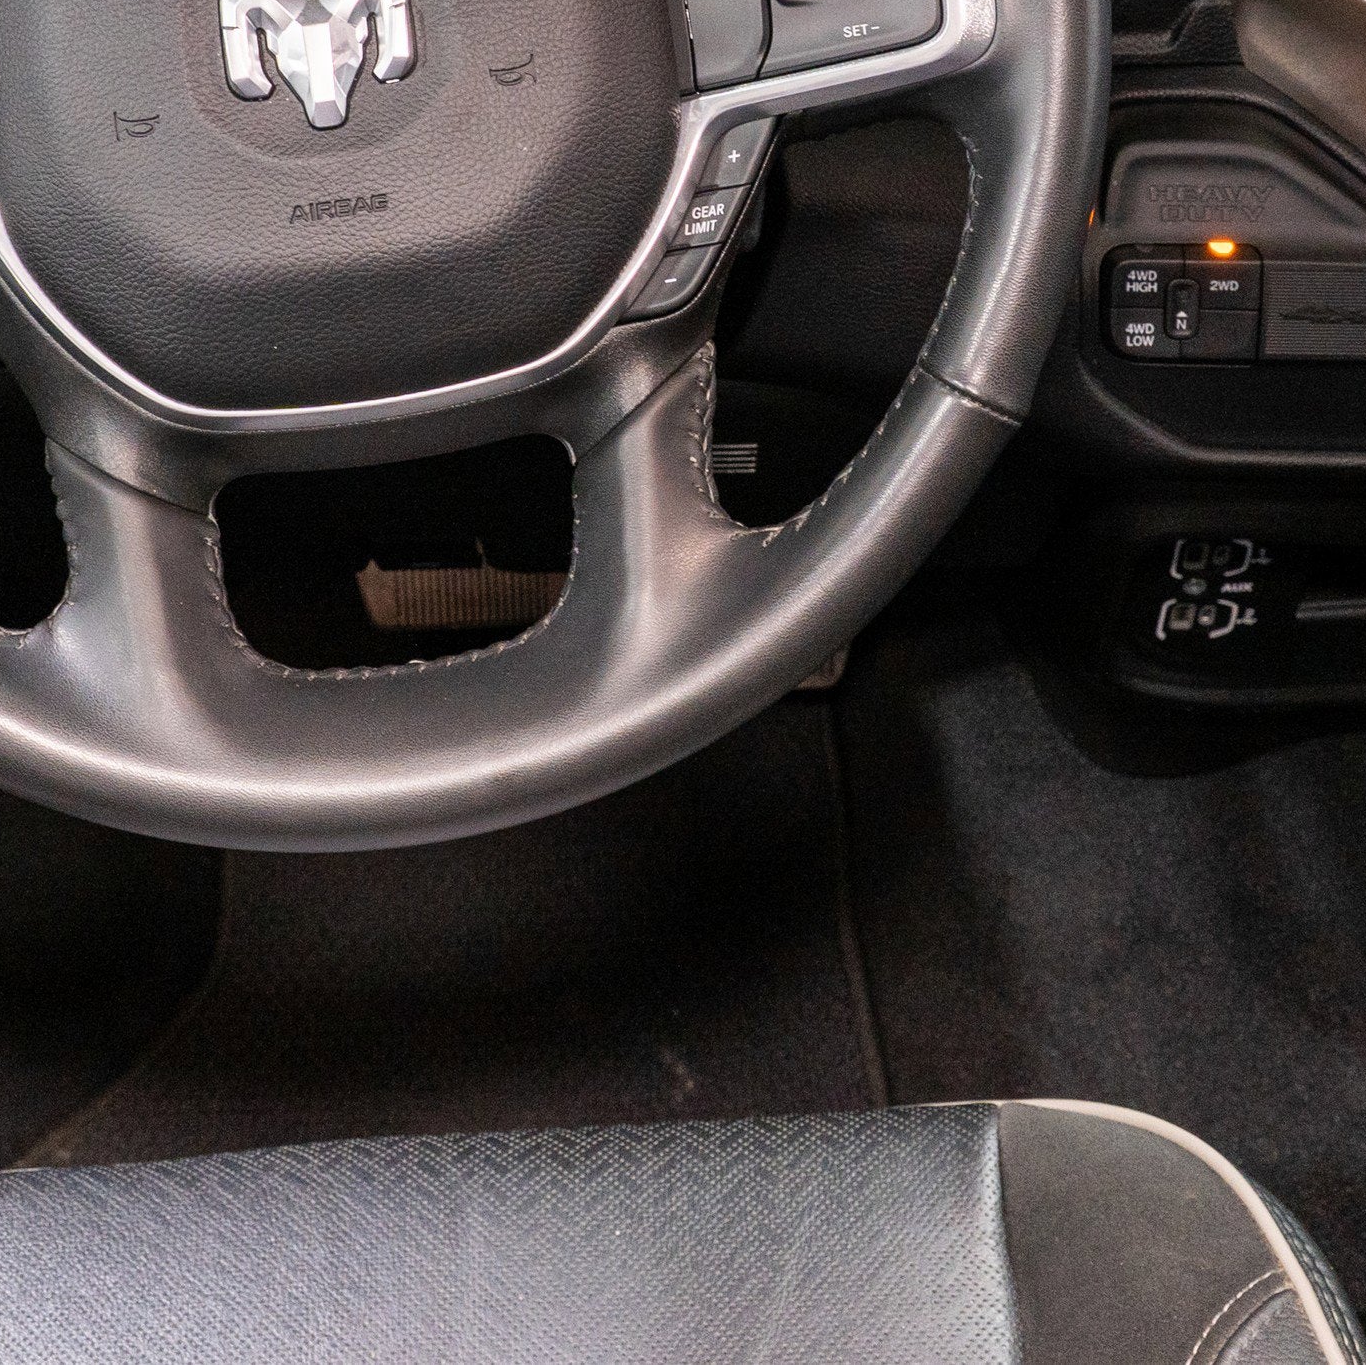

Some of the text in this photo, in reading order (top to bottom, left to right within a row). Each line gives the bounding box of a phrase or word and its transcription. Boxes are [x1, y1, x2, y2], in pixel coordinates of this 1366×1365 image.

[1149, 184, 1275, 204] HEAVY
[289, 193, 388, 224] AIRBAG
[691, 203, 725, 219] GEAR
[1160, 205, 1264, 223] DUTY
[684, 219, 718, 236] LIMIT
[1127, 270, 1158, 281] 4WD
[1126, 281, 1158, 292] HIGH
[1209, 280, 1240, 292] 2WD
[1125, 322, 1155, 335] 4WD
[1176, 318, 1187, 330] N
[1125, 335, 1155, 347] LOW
